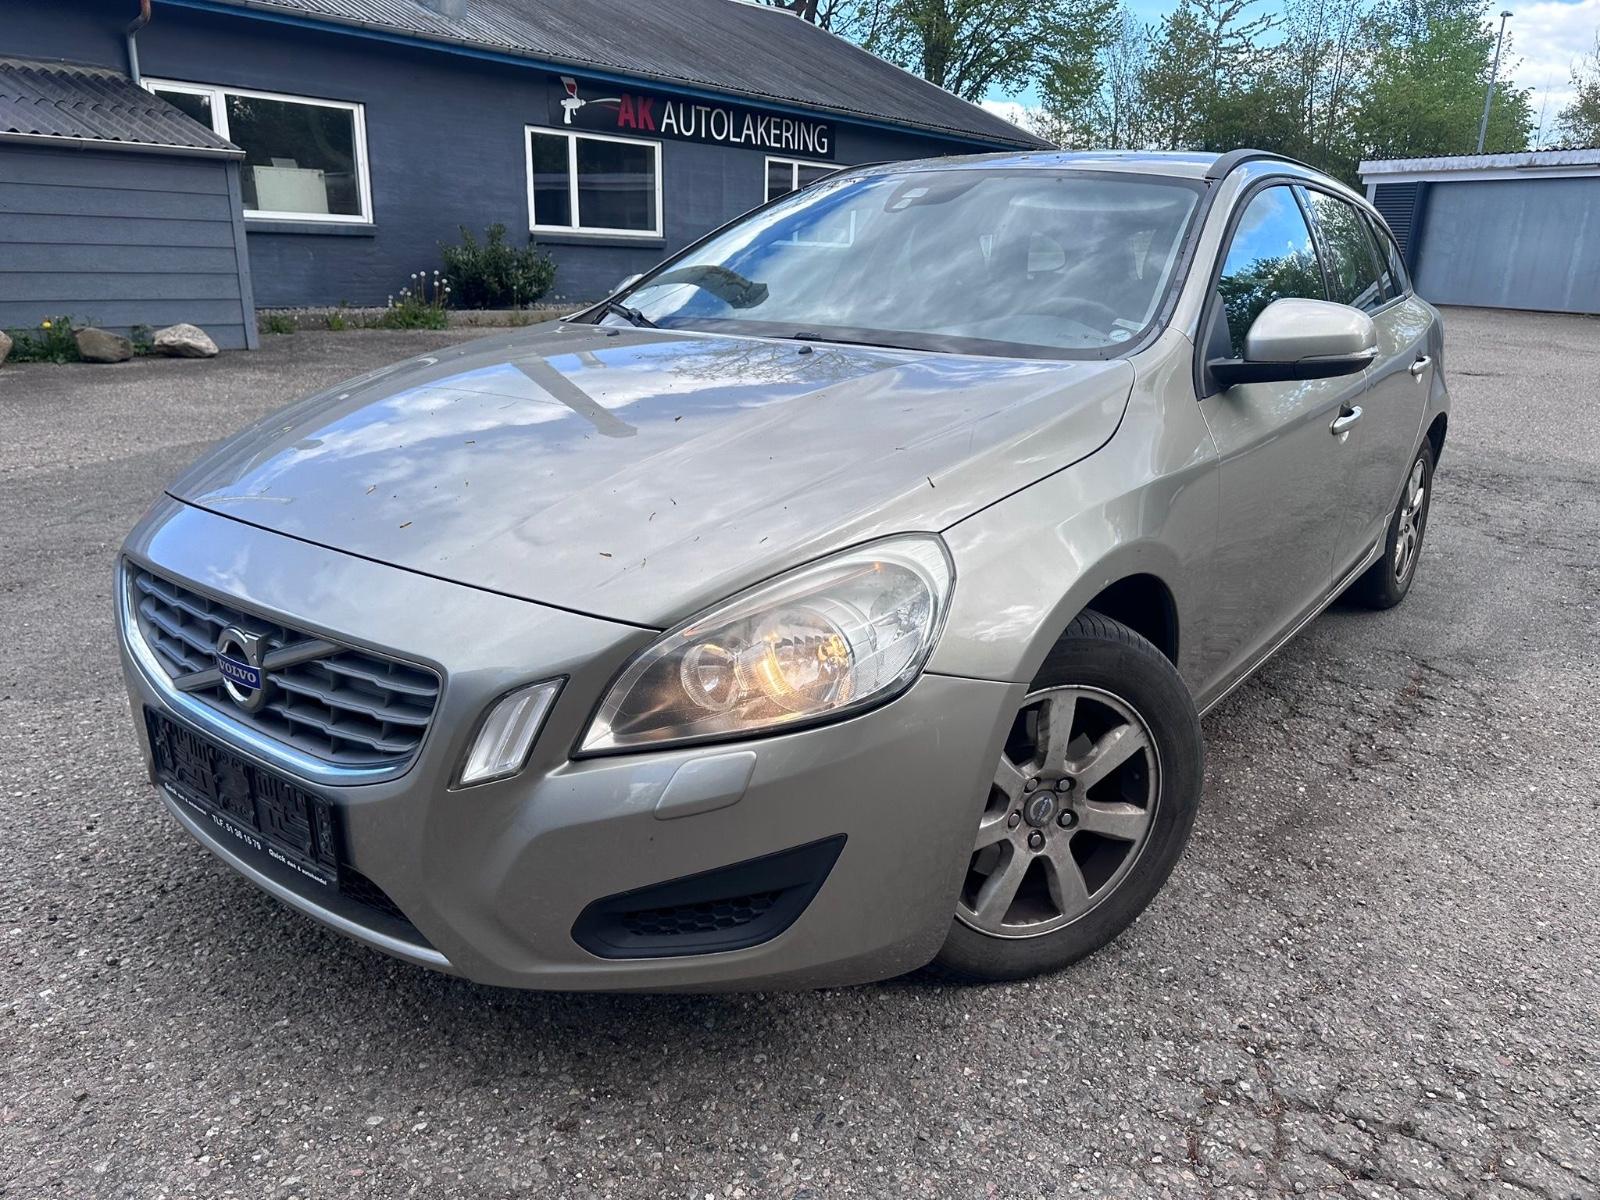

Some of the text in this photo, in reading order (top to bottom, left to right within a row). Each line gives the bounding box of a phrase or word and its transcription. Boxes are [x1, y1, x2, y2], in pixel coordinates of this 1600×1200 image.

[616, 94, 828, 154] AK AUTOLAKERING
[218, 659, 257, 683] VOLVO
[268, 848, 286, 864] Quick
